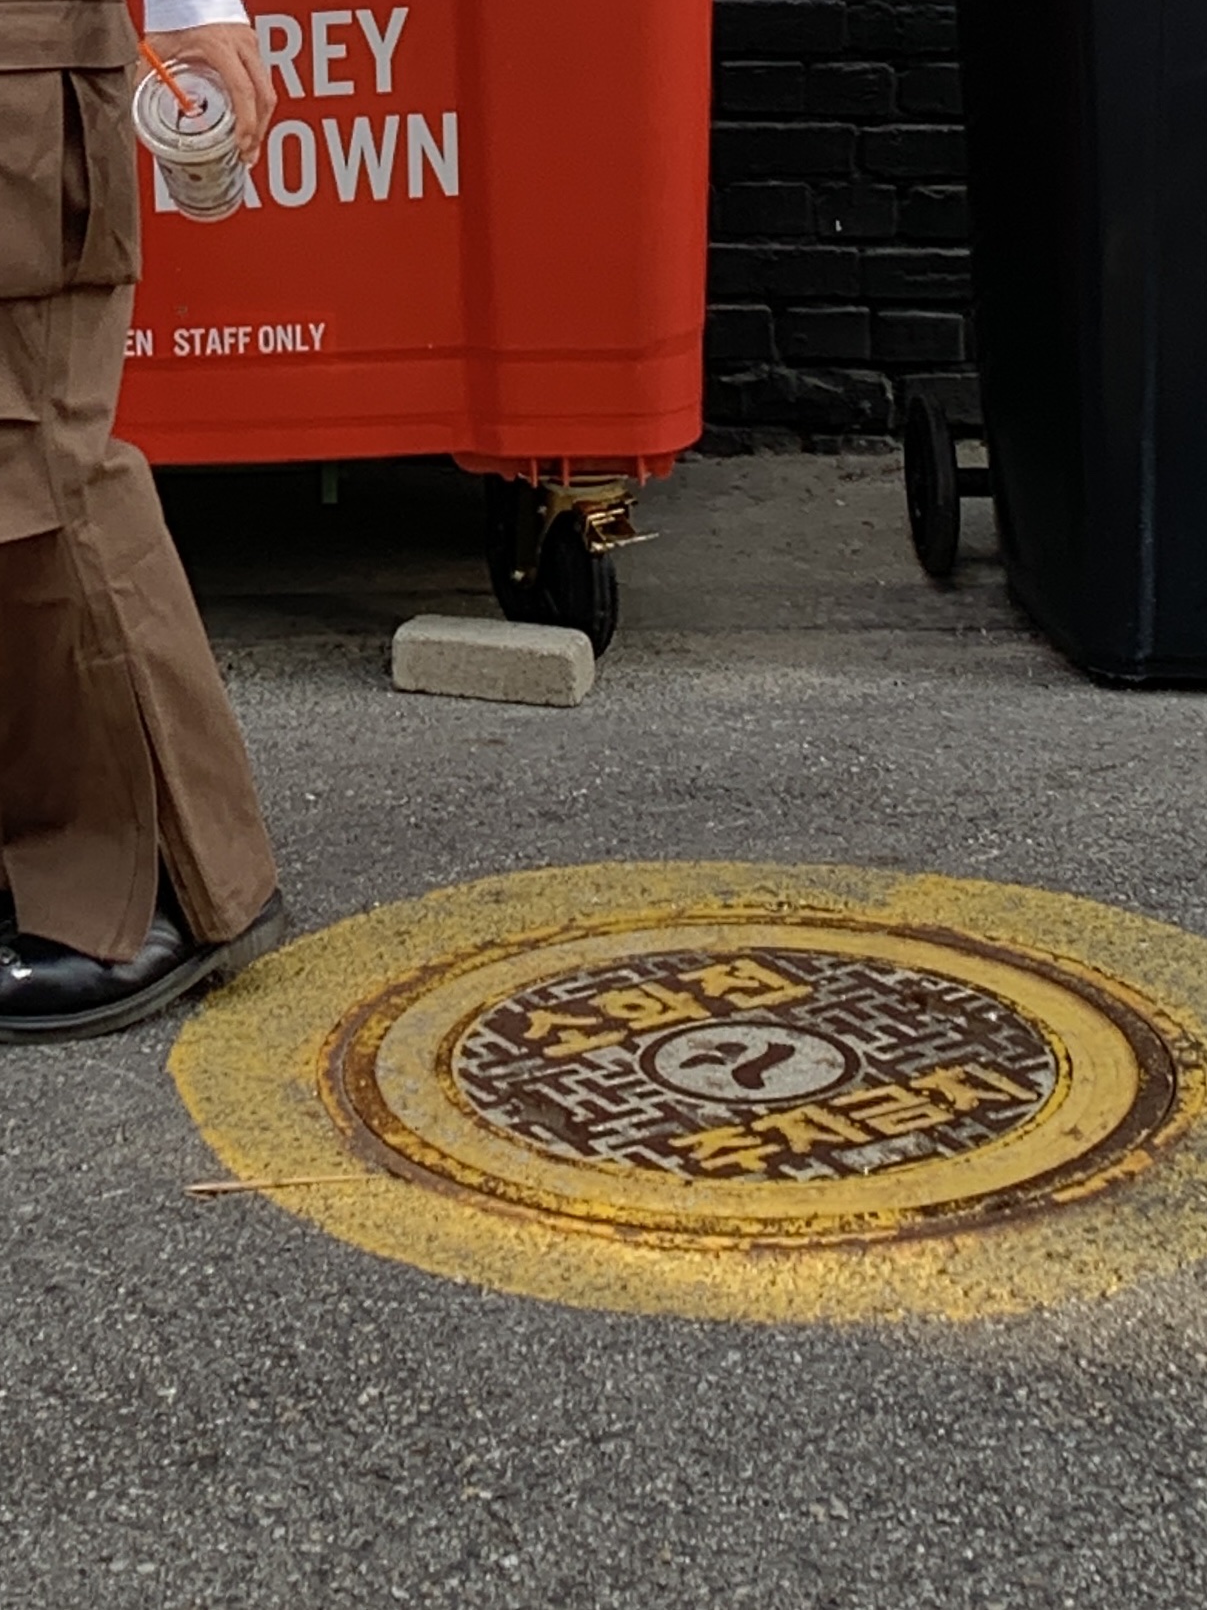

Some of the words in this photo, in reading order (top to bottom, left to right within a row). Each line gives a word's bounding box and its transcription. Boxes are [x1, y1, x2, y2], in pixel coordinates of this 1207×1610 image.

[153, 112, 461, 214] OWN
[172, 325, 253, 357] STAFF
[257, 322, 326, 355] ONLY
[523, 958, 813, 1058] 소화전
[668, 1061, 1039, 1173] 주차금지
